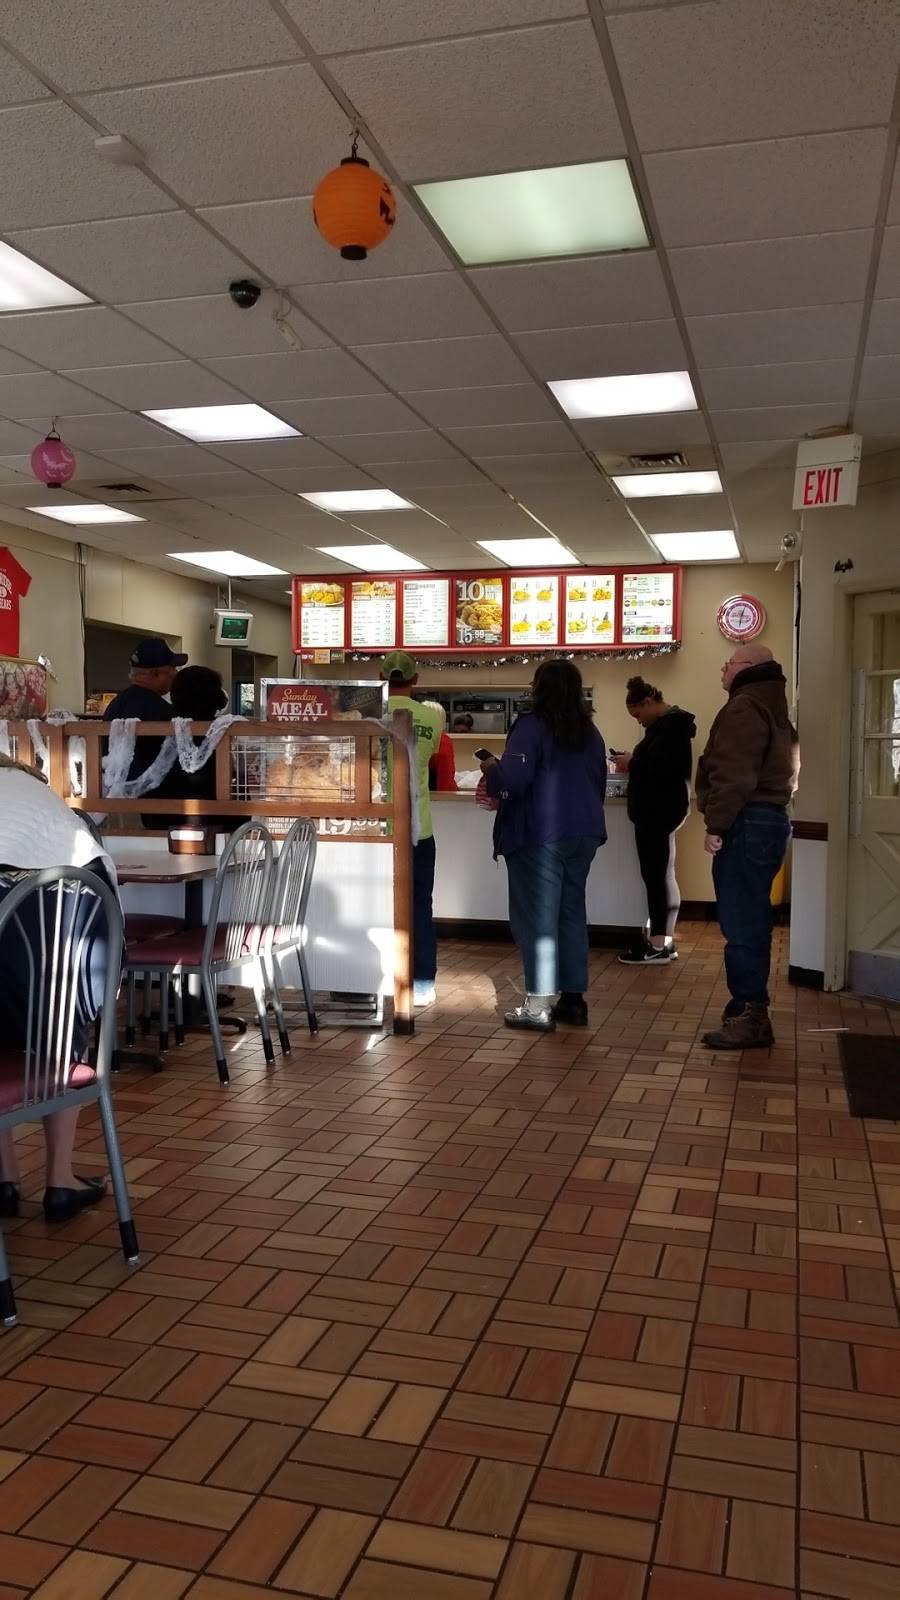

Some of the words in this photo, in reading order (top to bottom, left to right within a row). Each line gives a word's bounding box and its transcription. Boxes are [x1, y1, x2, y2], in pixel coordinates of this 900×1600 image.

[803, 467, 843, 505] EXIT
[458, 581, 485, 601] 10
[458, 628, 485, 644] 15.99
[282, 688, 318, 705] Sunday
[271, 702, 328, 716] MEAL
